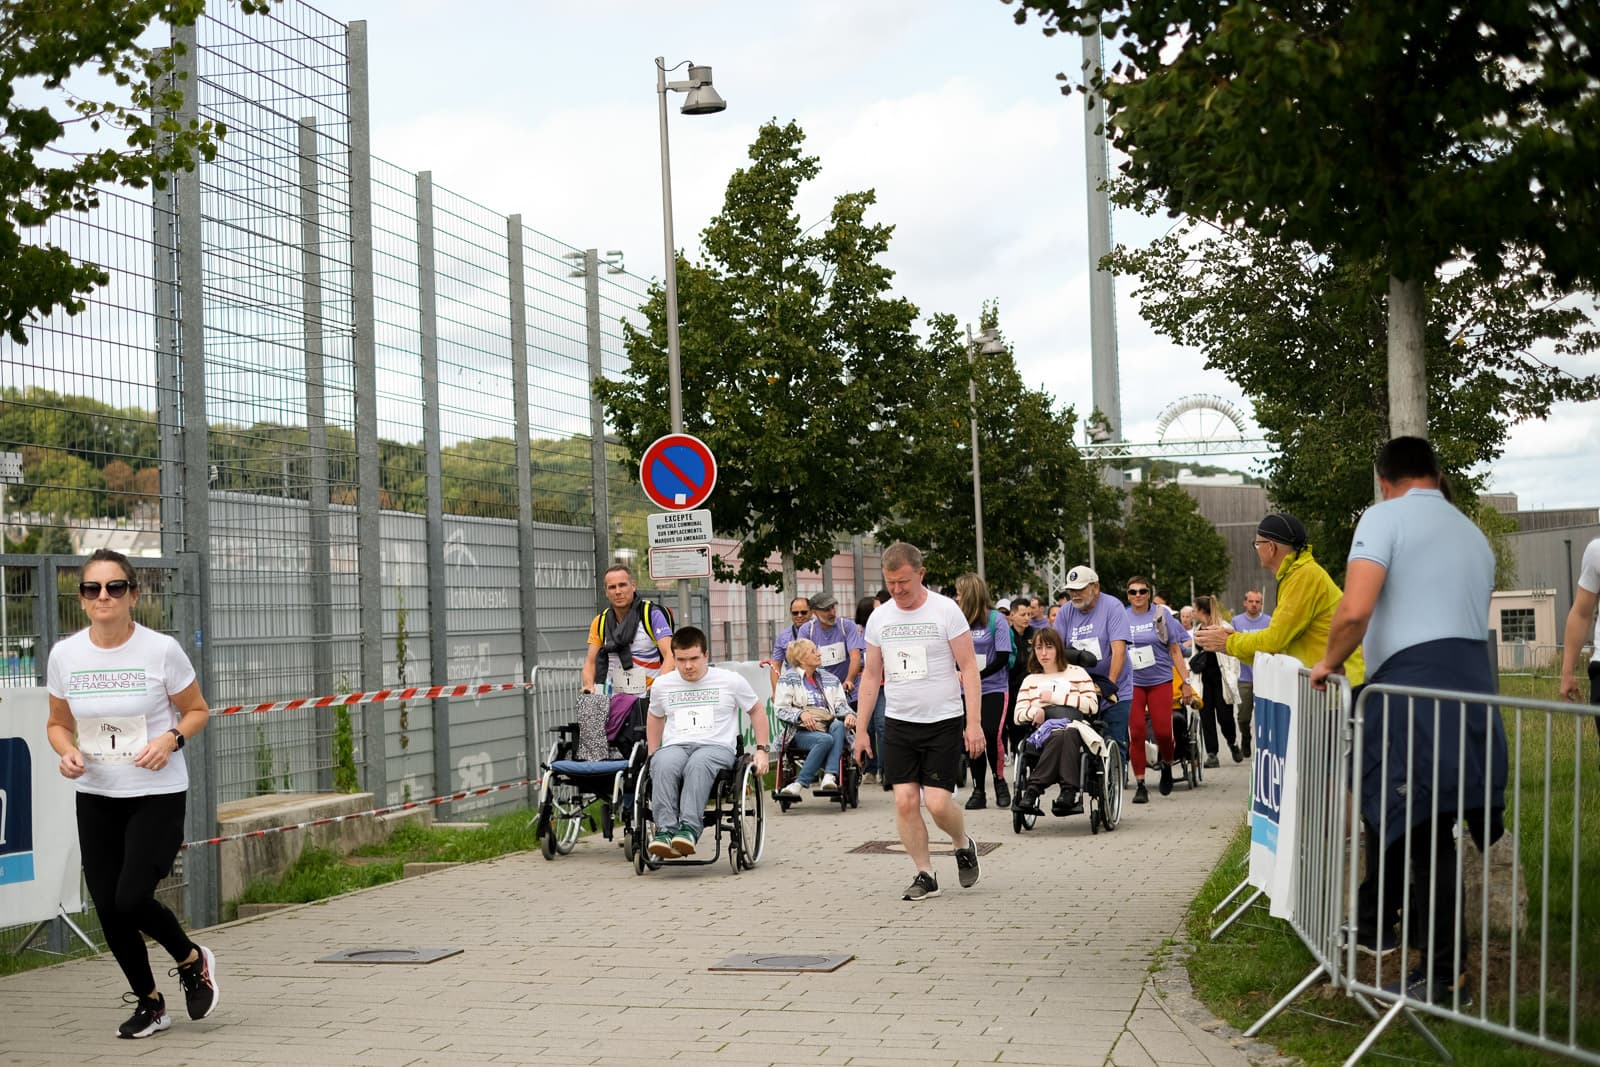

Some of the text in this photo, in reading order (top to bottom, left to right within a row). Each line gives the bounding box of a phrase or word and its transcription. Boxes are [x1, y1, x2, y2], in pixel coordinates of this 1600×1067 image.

[664, 514, 692, 522] EXCEPTE
[668, 528, 702, 536] EMPLACEMENTS
[903, 660, 907, 670] 1
[92, 672, 146, 681] MILLIONS
[82, 680, 130, 690] RAISONS
[110, 734, 115, 749] 1
